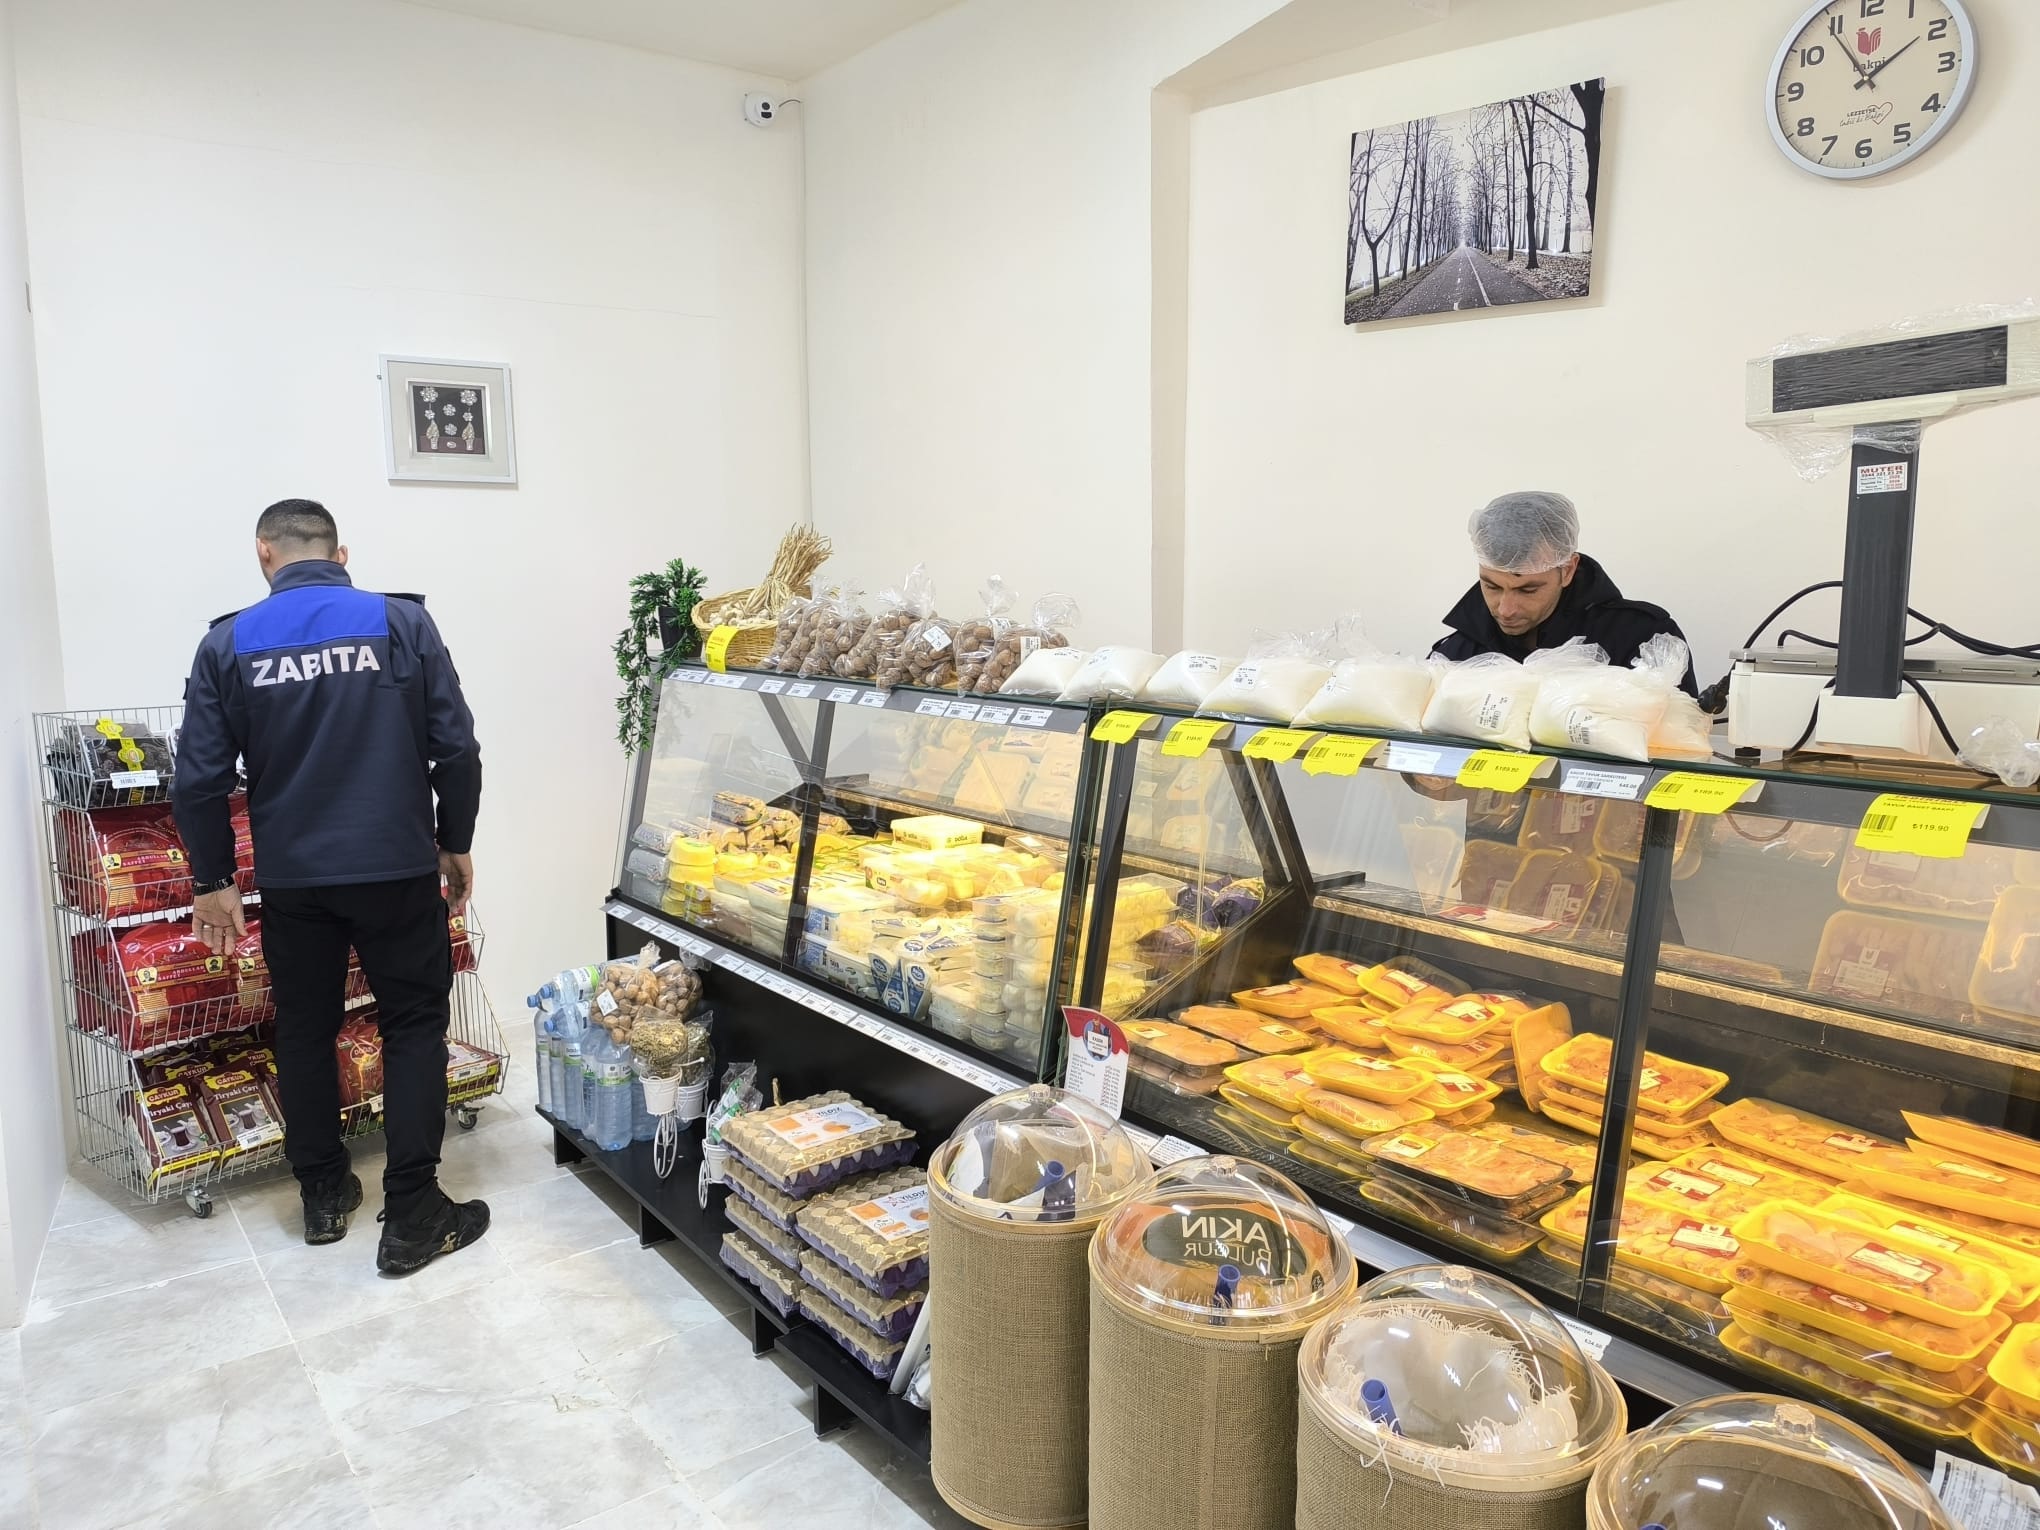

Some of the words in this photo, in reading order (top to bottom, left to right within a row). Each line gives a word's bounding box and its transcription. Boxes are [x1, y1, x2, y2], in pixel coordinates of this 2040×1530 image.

[1860, 0, 1884, 18] 12
[1908, 0, 1915, 18] 1
[1829, 15, 1843, 36] 11
[1927, 18, 1948, 41] 2
[1800, 45, 1825, 68] 10
[1937, 51, 1956, 73] 3
[1787, 82, 1804, 102] 9
[1920, 93, 1941, 113] 4
[1797, 117, 1815, 136] 8
[1893, 122, 1911, 144] 5
[1821, 135, 1838, 156] 7
[1854, 138, 1873, 159] 6
[251, 645, 381, 687] ZABITA
